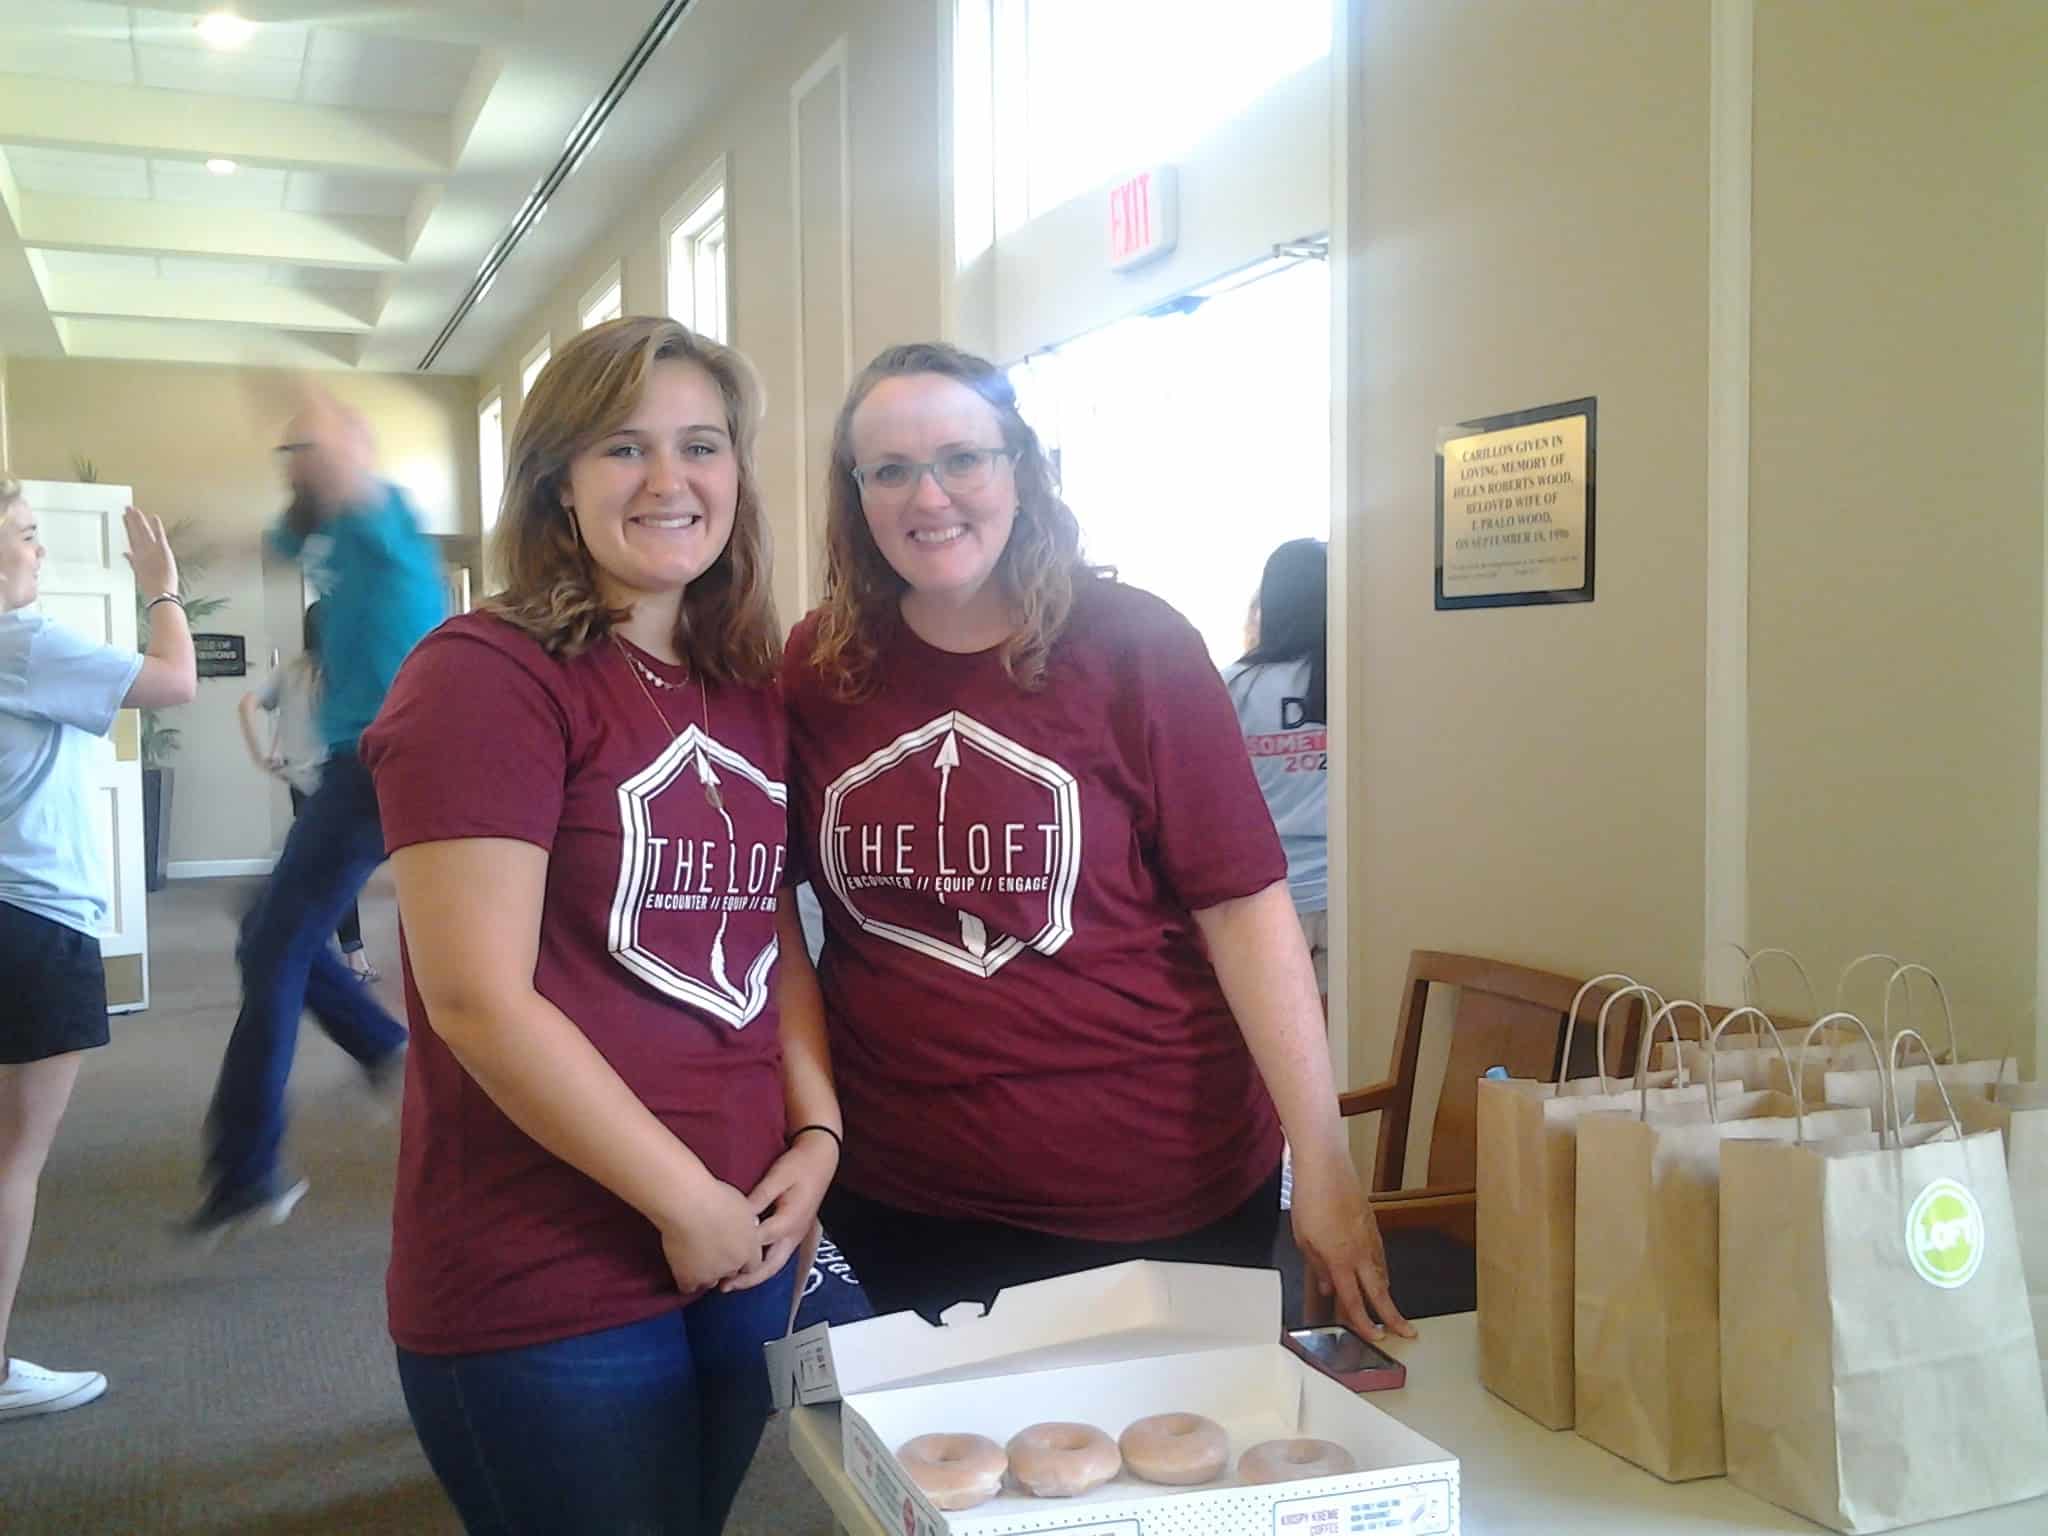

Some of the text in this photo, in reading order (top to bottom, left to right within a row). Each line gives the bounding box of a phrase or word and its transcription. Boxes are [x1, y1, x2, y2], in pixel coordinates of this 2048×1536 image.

[1110, 172, 1151, 260] EXIT
[1462, 434, 1564, 462] CARILLON GIVEN IN
[1460, 453, 1565, 481] LOVING MEMORY OF
[1453, 484, 1486, 498] HELEN
[1487, 477, 1536, 494] ROBERTS
[1466, 491, 1559, 514] BELOVED WIFE OF
[1471, 531, 1532, 549] SEPTEMBER
[835, 823, 1061, 876] THE LOFT
[647, 837, 717, 894] THE
[846, 875, 912, 891] ENCOUNTER
[935, 876, 975, 891] EQUIP
[998, 875, 1049, 892] ENGAGE
[645, 889, 708, 911] ENCOUNTER
[721, 896, 748, 911] EQUIP
